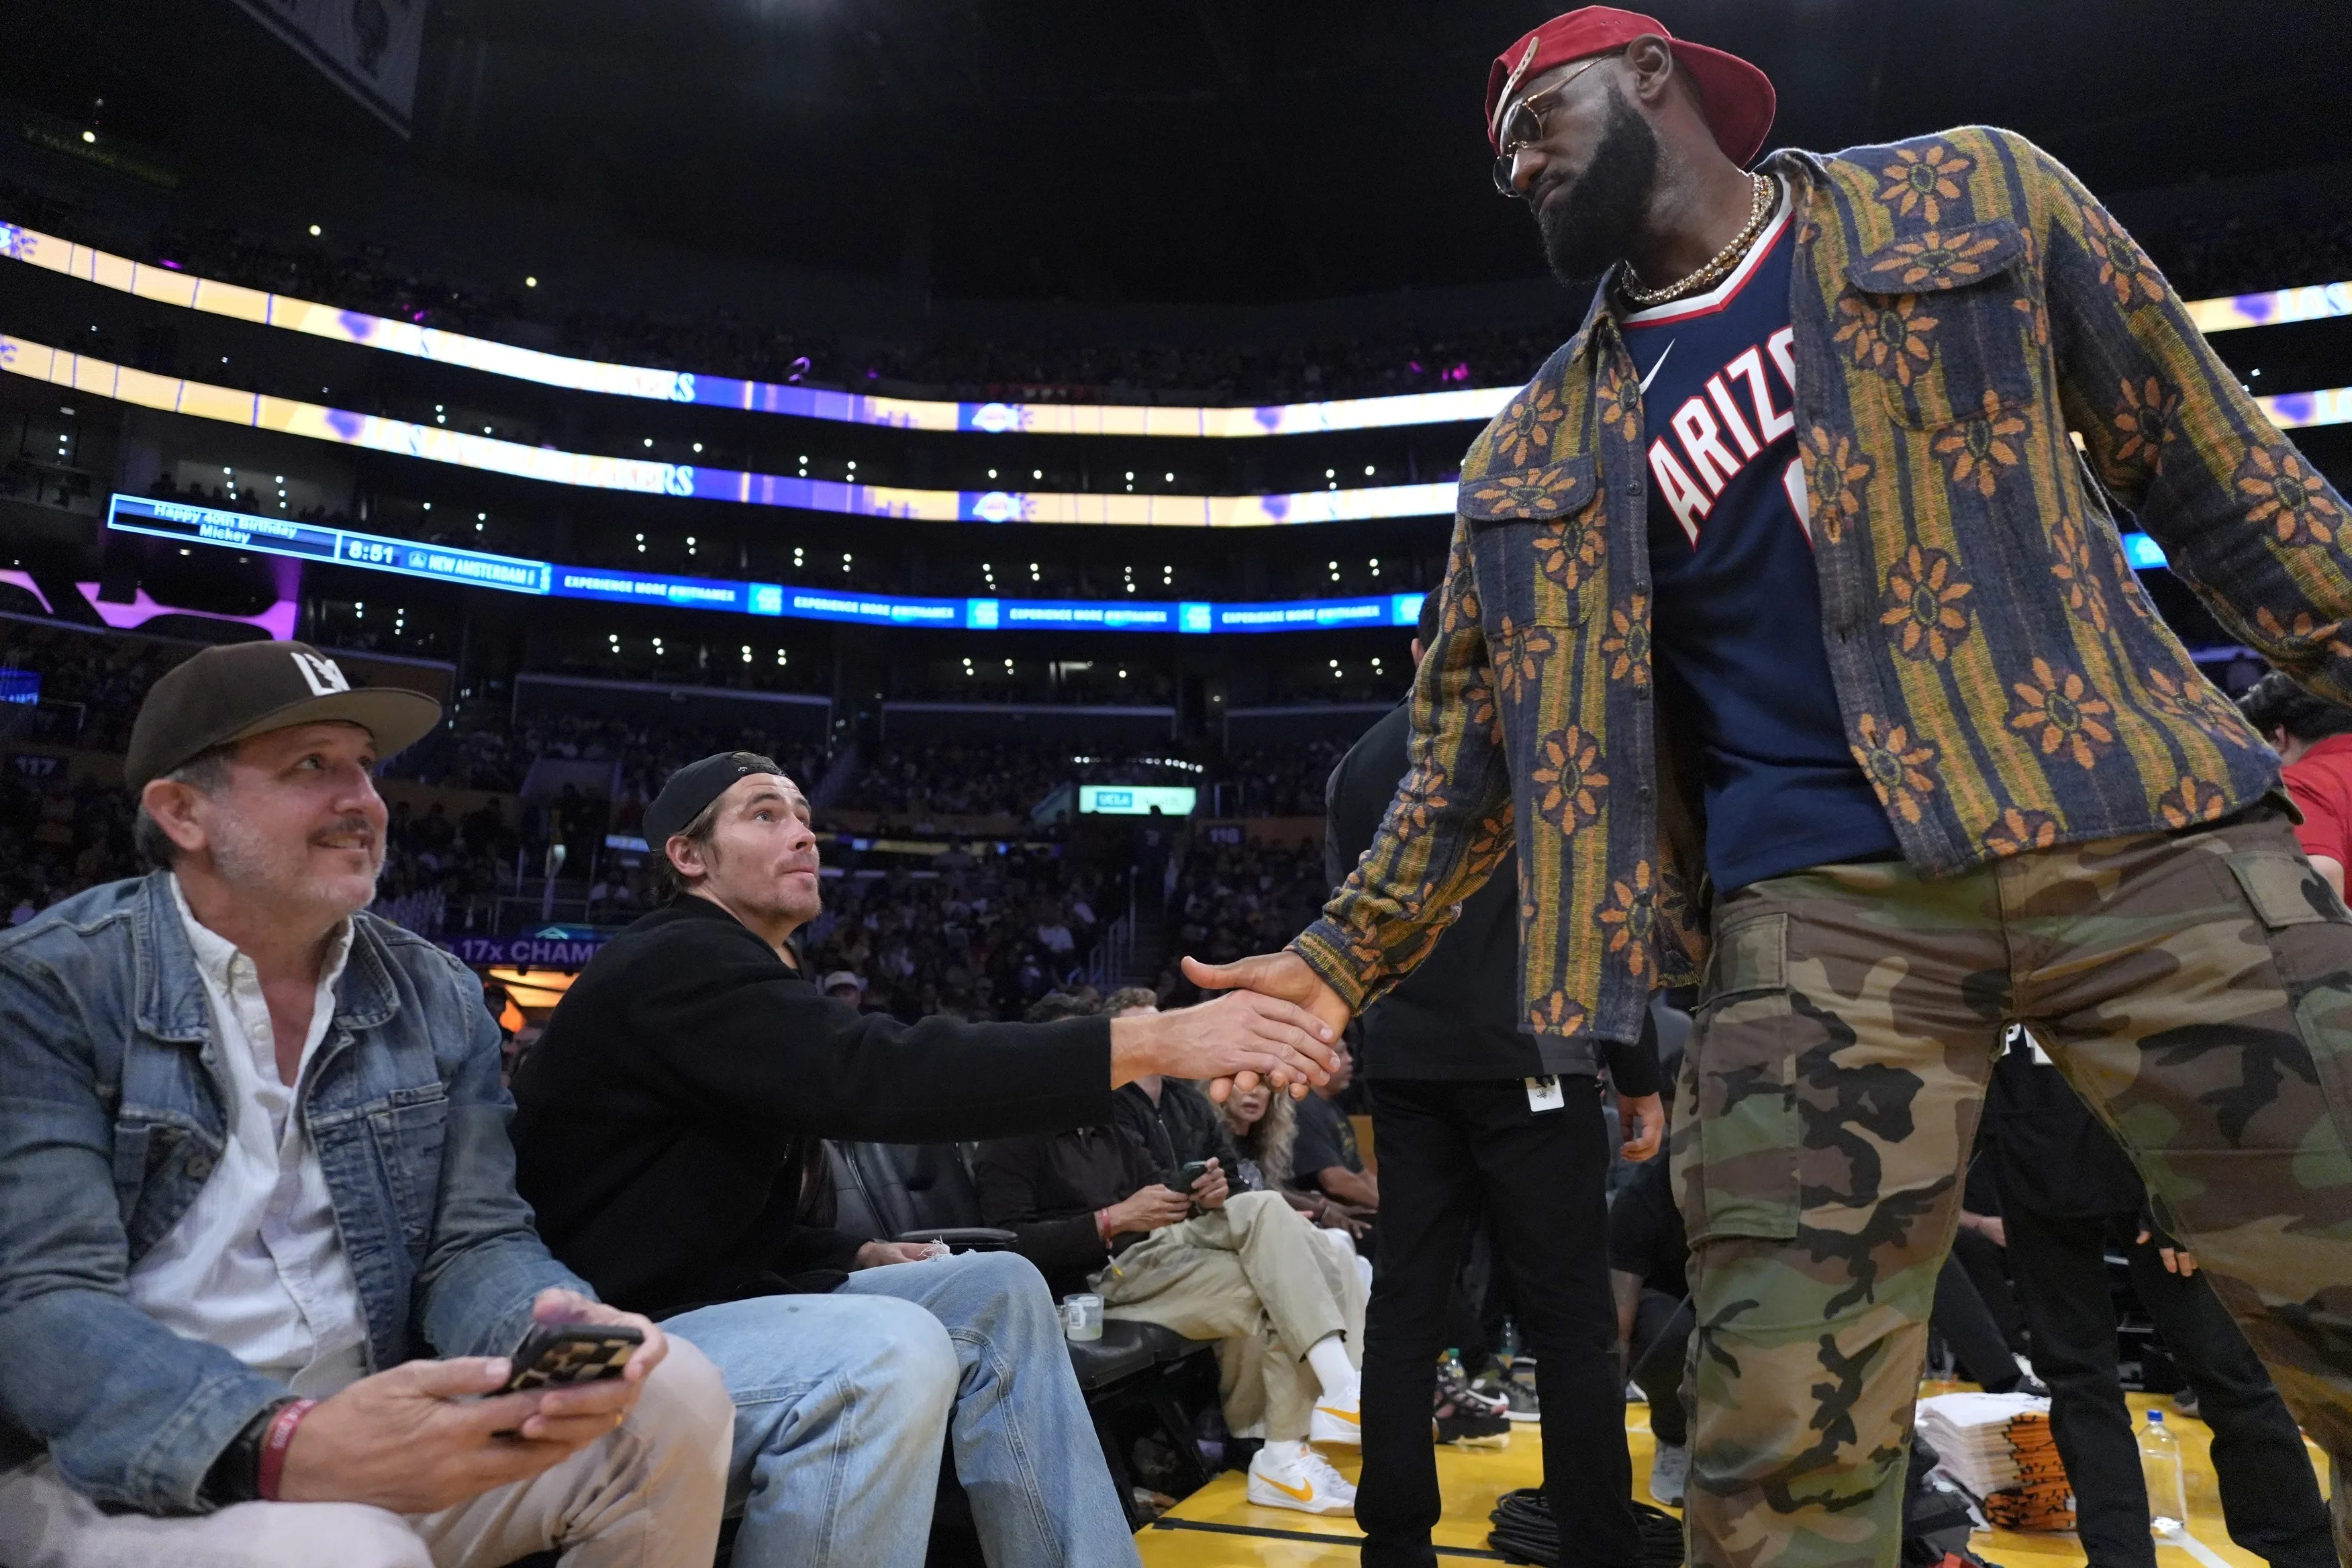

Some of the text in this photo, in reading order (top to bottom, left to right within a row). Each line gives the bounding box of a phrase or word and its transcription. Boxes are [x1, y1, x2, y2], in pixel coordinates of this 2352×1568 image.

[154, 503, 297, 539] Happy 40th Birthday
[199, 524, 251, 544] Mickey
[428, 554, 456, 573] NEW
[454, 559, 527, 585] AMSTERDAM
[565, 575, 633, 593] EXPERIENCE
[635, 581, 667, 596] MORE
[794, 596, 858, 613] EXPERIENCE
[860, 603, 891, 616] MORE
[1010, 608, 1072, 621] EXPERIENCE
[1222, 610, 1285, 624] EXPERIENCE
[15, 756, 57, 776] 117
[462, 939, 503, 962] 17x
[510, 940, 603, 964] CHAM
